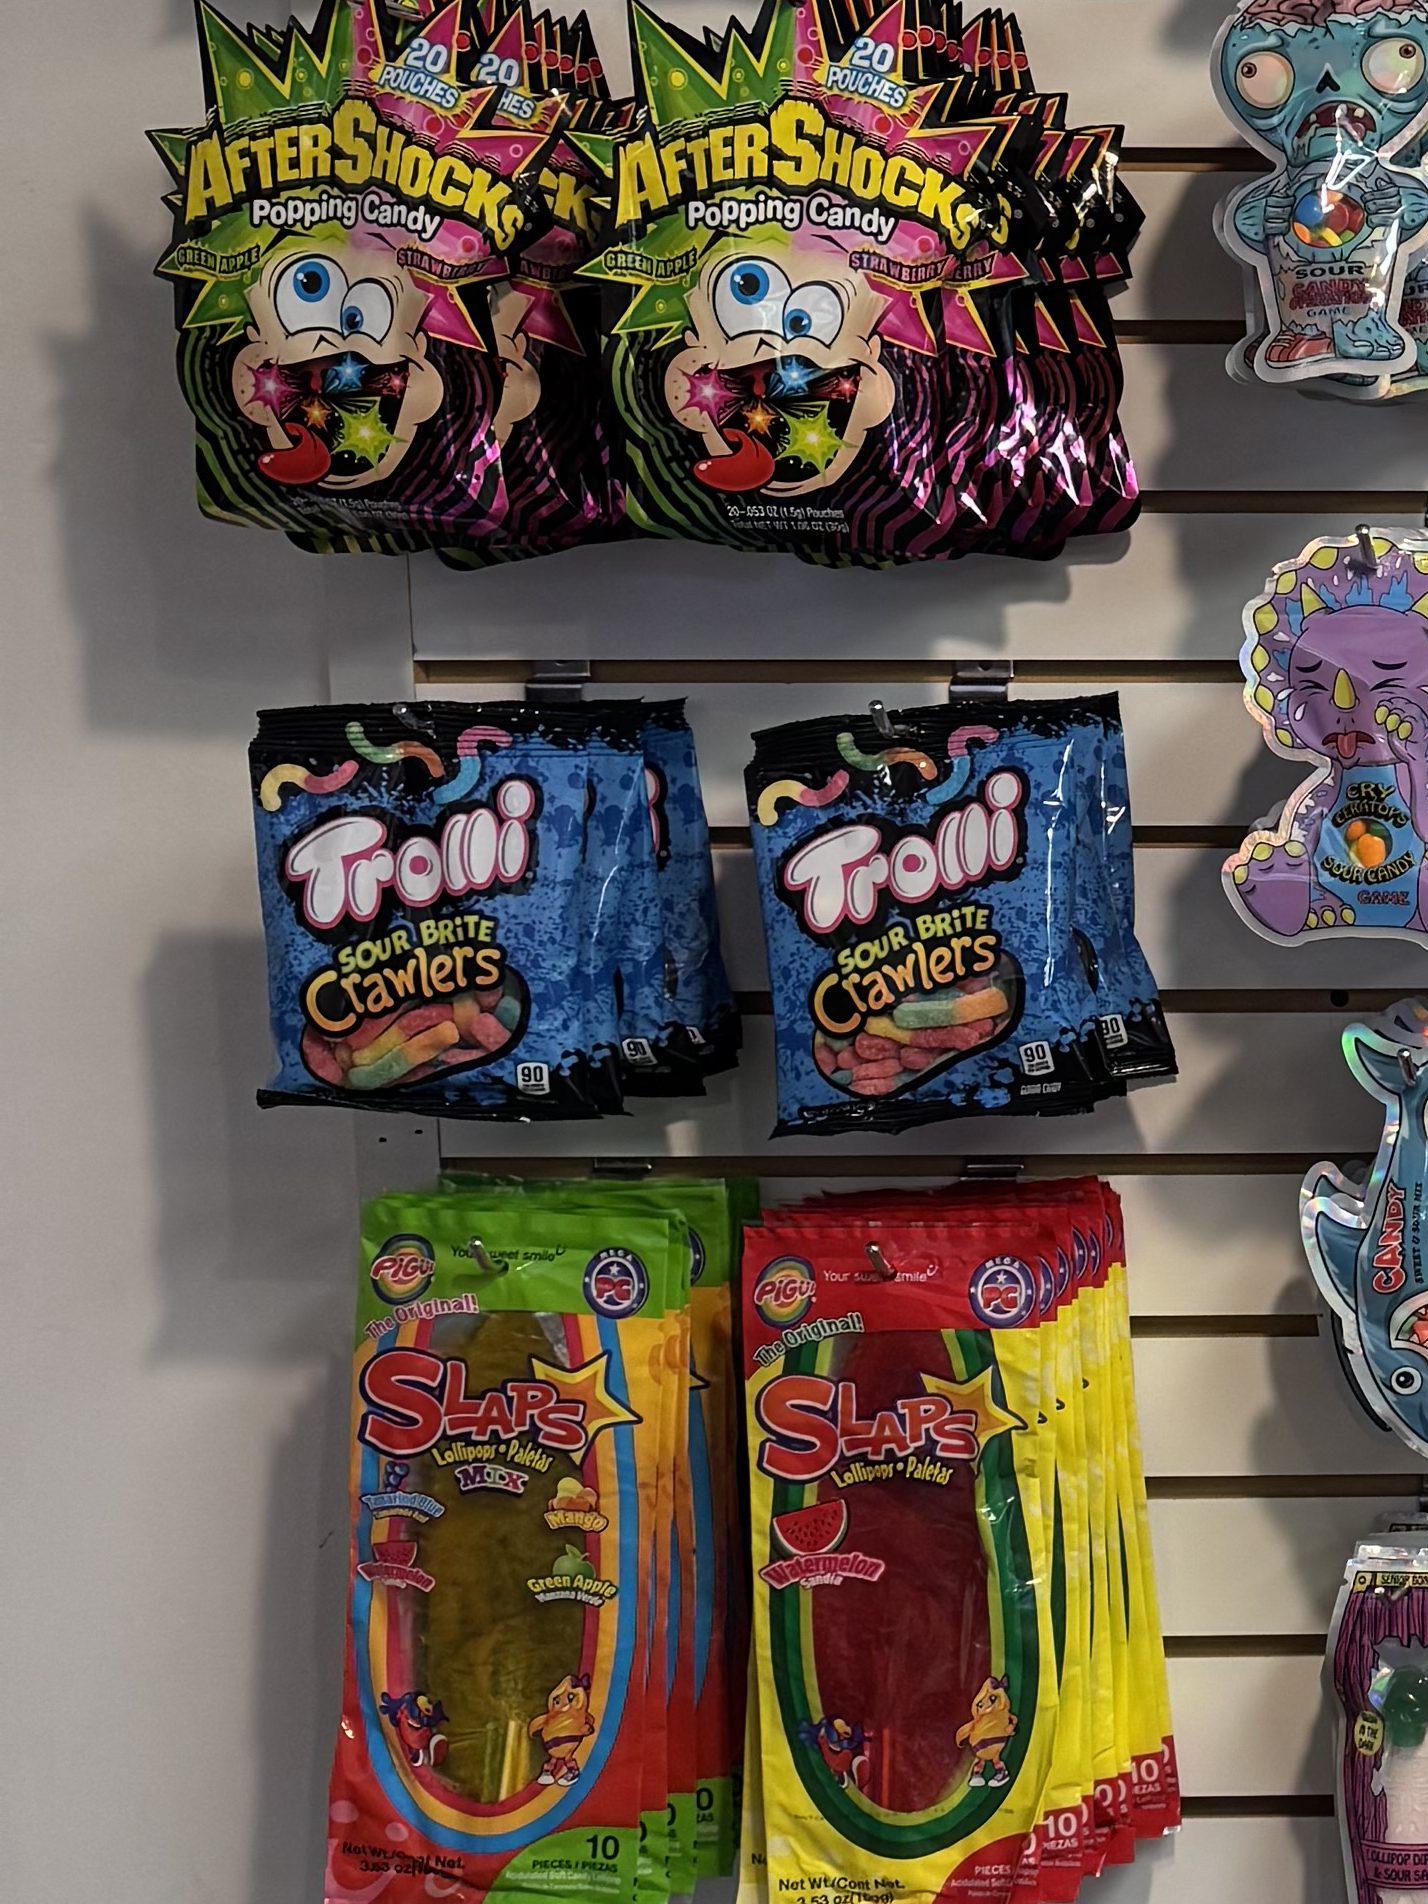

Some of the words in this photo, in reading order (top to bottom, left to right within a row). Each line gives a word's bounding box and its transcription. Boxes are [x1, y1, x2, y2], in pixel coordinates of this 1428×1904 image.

[404, 36, 449, 74] 20
[852, 35, 895, 74] 20
[378, 65, 458, 108] POUCHES
[252, 193, 358, 227] Popping
[360, 197, 442, 240] Candy
[688, 193, 802, 228] Popping
[807, 196, 896, 241] Candy
[1295, 263, 1365, 280] SOUR
[1345, 782, 1396, 801] CRY
[286, 778, 536, 930] Trolli
[785, 770, 1023, 934] Trolli
[1356, 889, 1411, 907] GAME
[306, 948, 502, 1033] Crawlers
[814, 934, 998, 1034] Crawlers
[823, 1269, 850, 1281] Your
[365, 1313, 396, 1342] The
[395, 1292, 482, 1327] Original!
[365, 1347, 586, 1454] SLAPS
[759, 1374, 981, 1478] SLAPS
[458, 1464, 528, 1495] MIX
[831, 1459, 894, 1486] Lollipops
[904, 1457, 954, 1486] Paletas
[543, 1508, 607, 1534] Mango
[527, 1573, 564, 1597] Green
[569, 1573, 617, 1601] Apple
[762, 1552, 886, 1586] Watermelon
[1044, 1810, 1078, 1836] 10
[586, 1834, 621, 1860] 10
